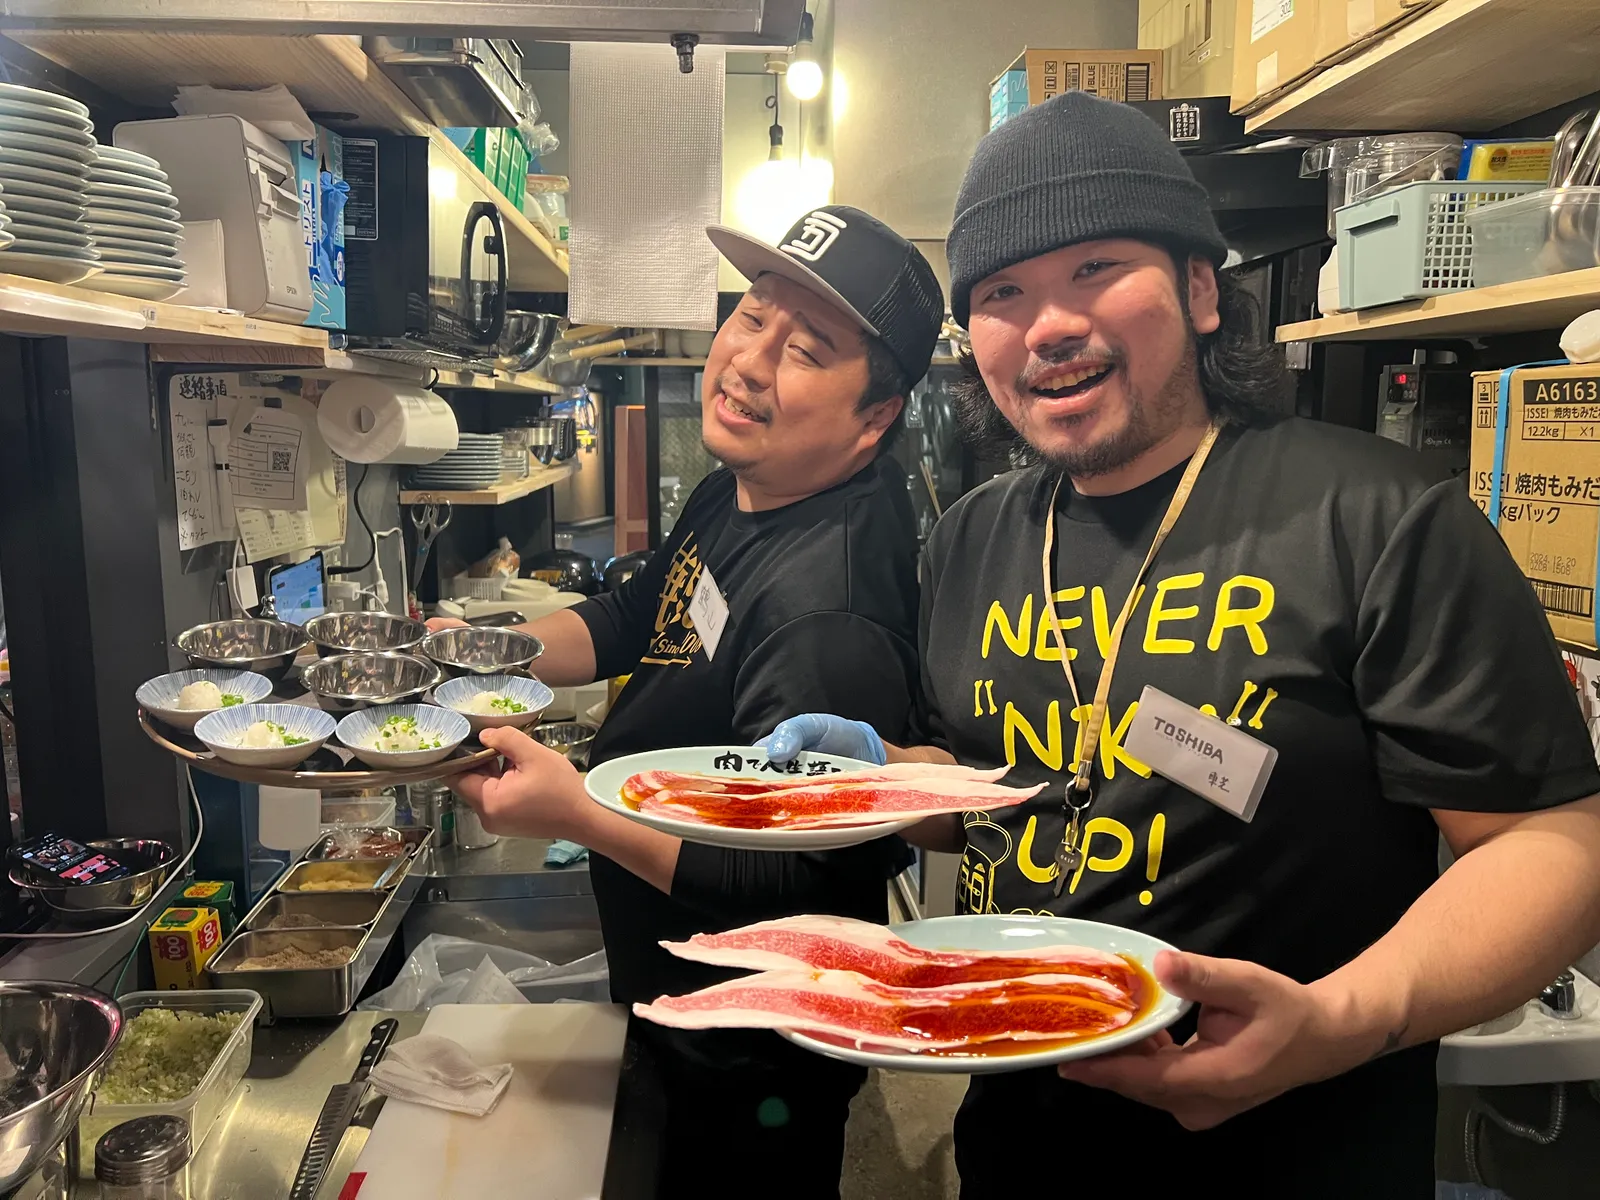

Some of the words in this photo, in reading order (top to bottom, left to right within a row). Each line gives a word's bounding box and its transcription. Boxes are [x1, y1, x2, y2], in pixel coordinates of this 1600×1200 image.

[1535, 381, 1597, 402] A6163
[1526, 407, 1549, 419] ISSEI
[981, 572, 1275, 661] NEVER
[1154, 716, 1224, 765] TOSHIBA
[1017, 812, 1166, 906] UP!
[168, 935, 179, 960] 100
